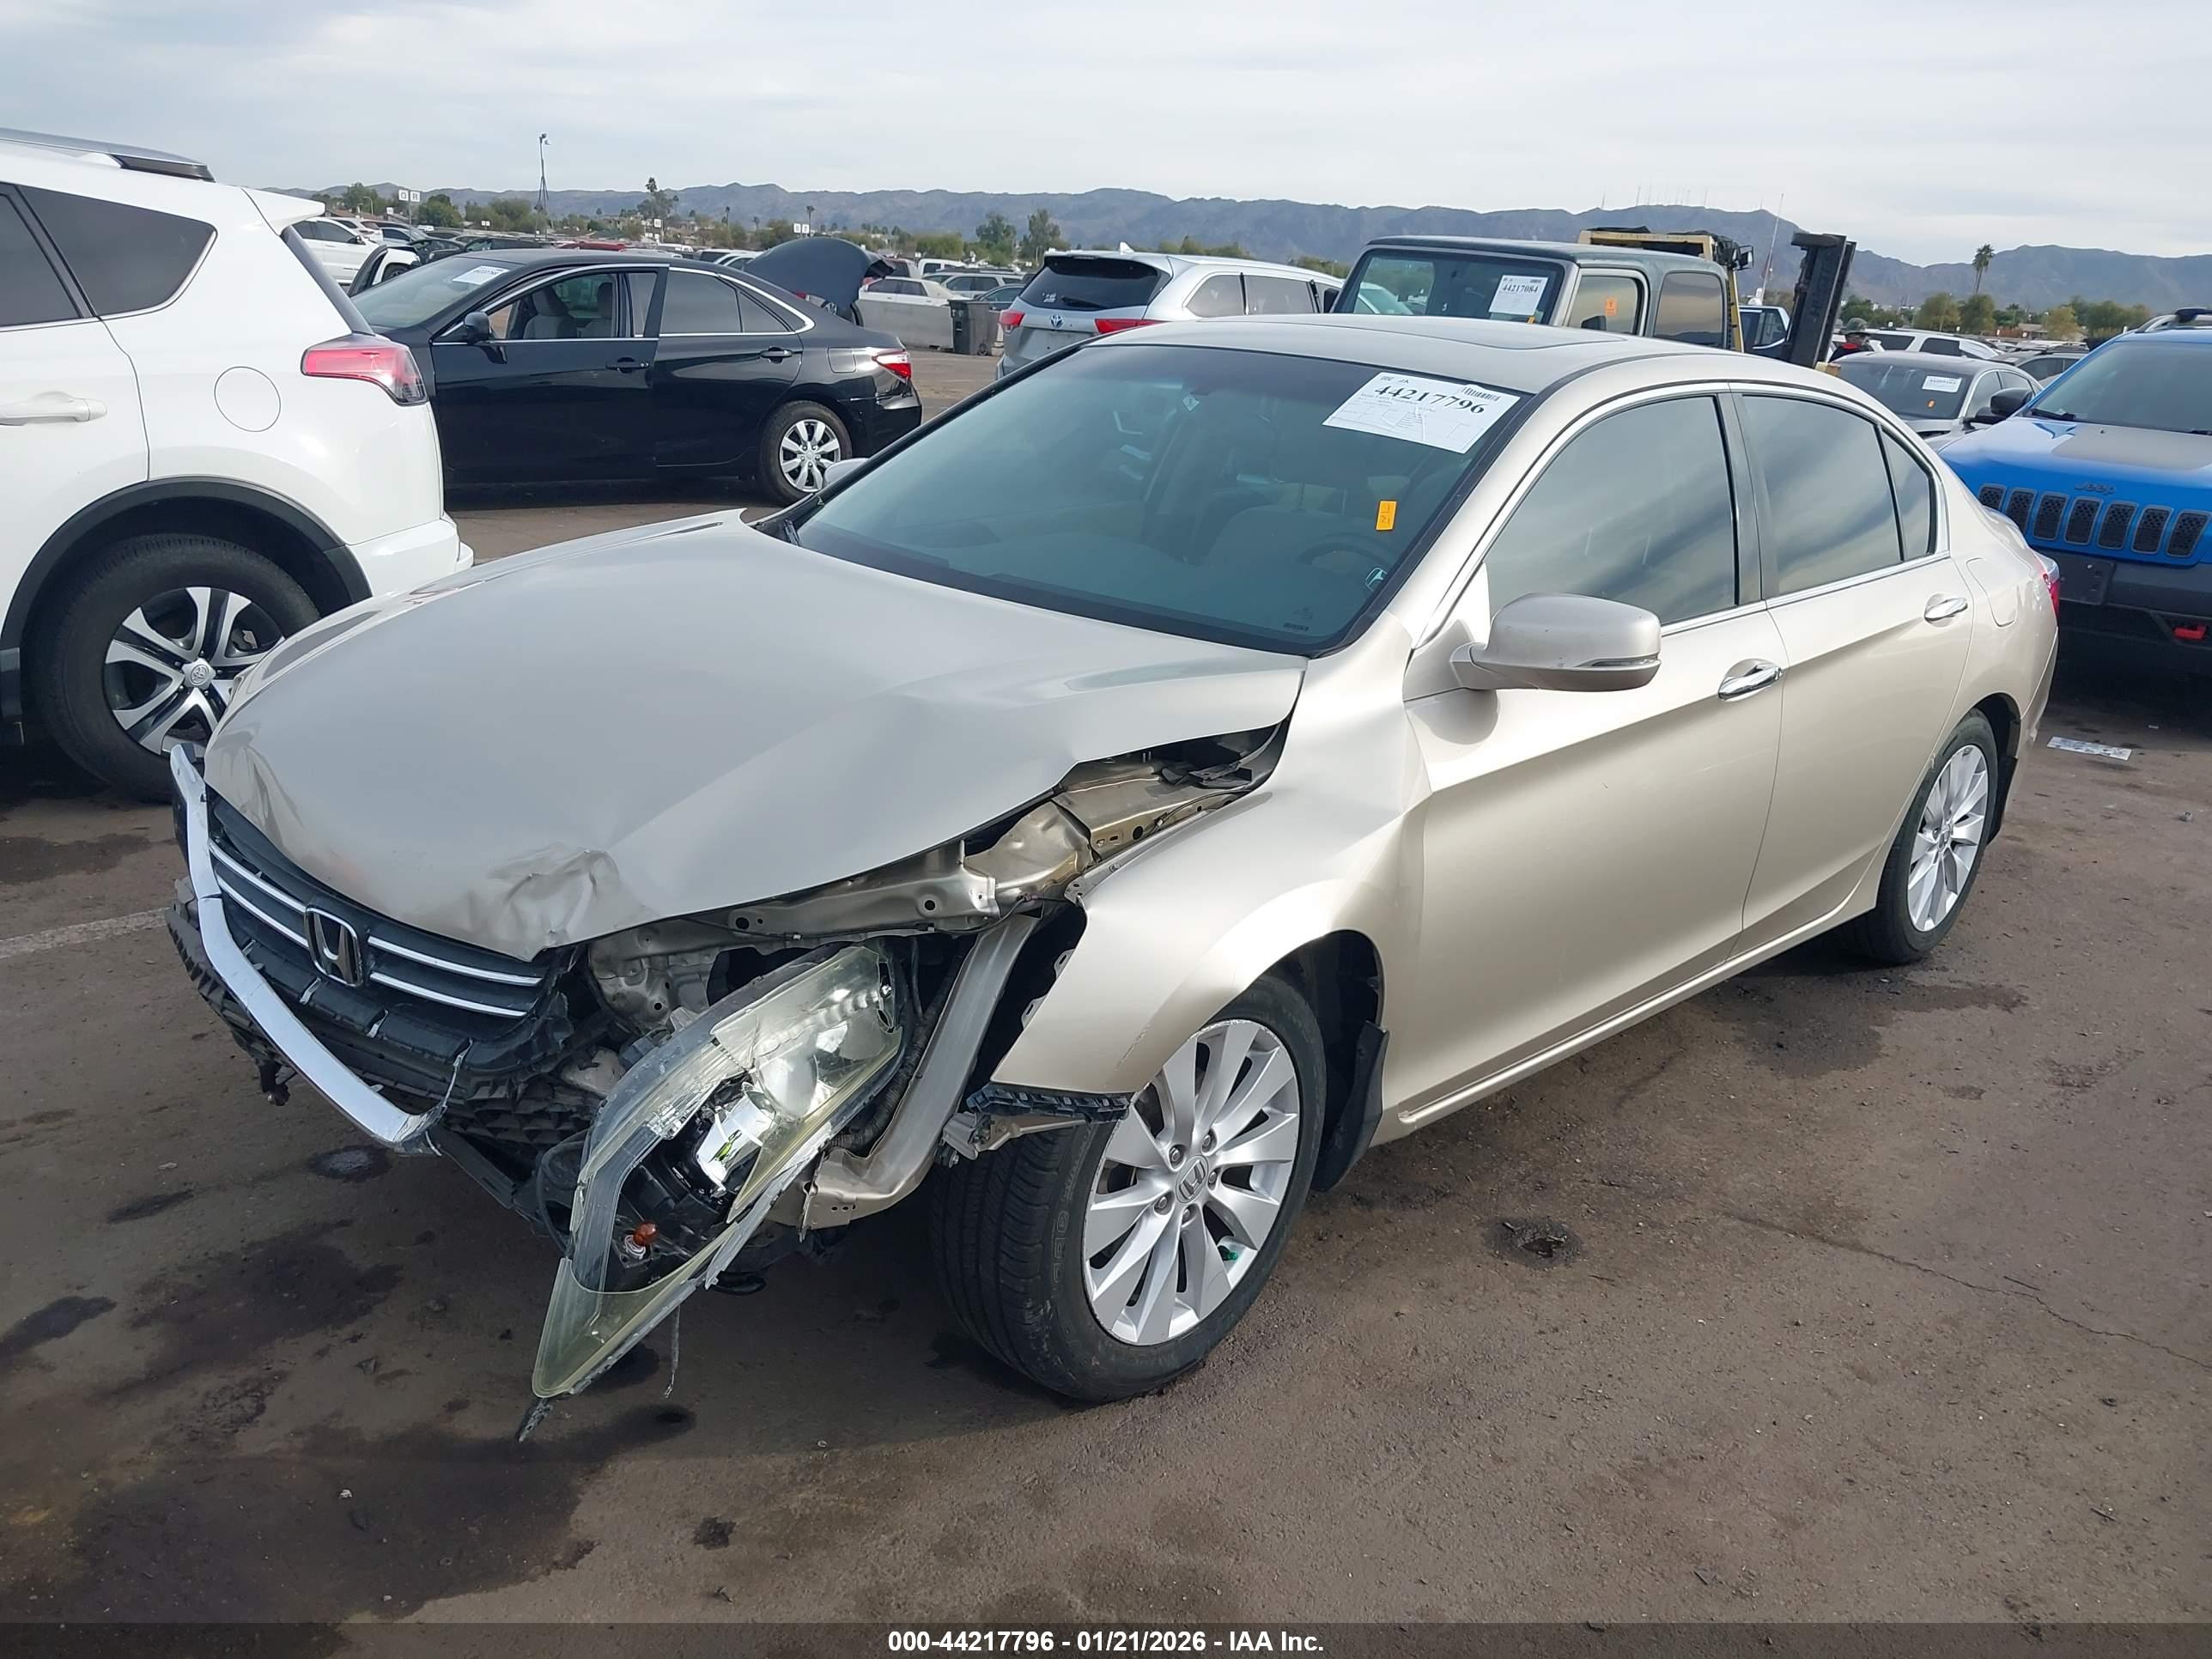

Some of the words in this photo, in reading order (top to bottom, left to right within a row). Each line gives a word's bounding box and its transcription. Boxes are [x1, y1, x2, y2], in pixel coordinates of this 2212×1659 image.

[1502, 283, 1540, 294] 44217084
[1375, 386, 1489, 414] 44217796
[2074, 481, 2116, 495] Jeep
